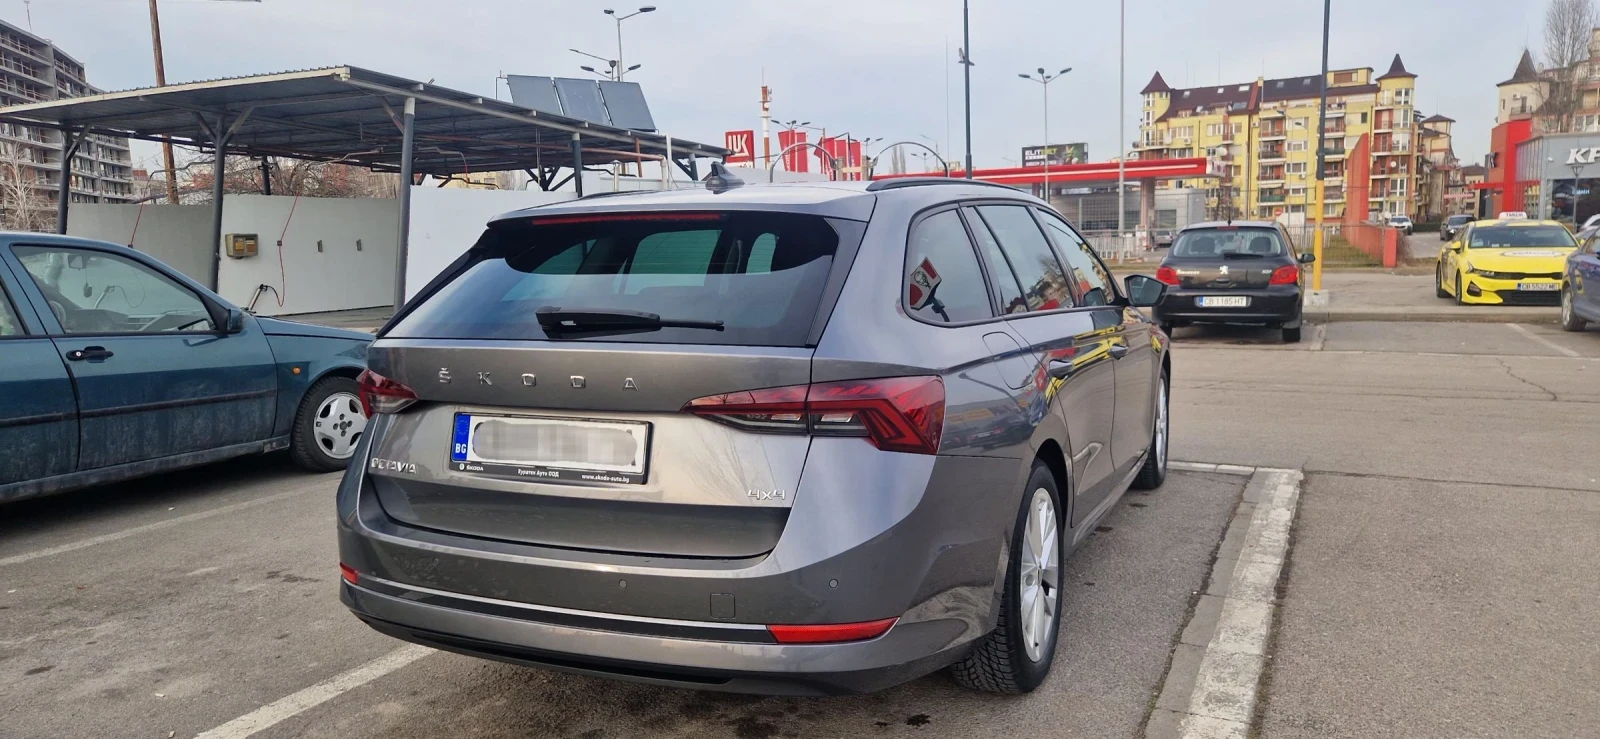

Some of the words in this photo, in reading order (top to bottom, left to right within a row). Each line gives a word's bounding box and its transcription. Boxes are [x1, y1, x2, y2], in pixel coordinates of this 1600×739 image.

[1204, 297, 1214, 305] CB
[438, 367, 639, 392] ŠKODA
[455, 443, 467, 454] BG
[371, 457, 417, 475] OCTAVIA
[581, 474, 630, 484] www.skoda-auto.bg
[747, 489, 785, 501] 4x4
